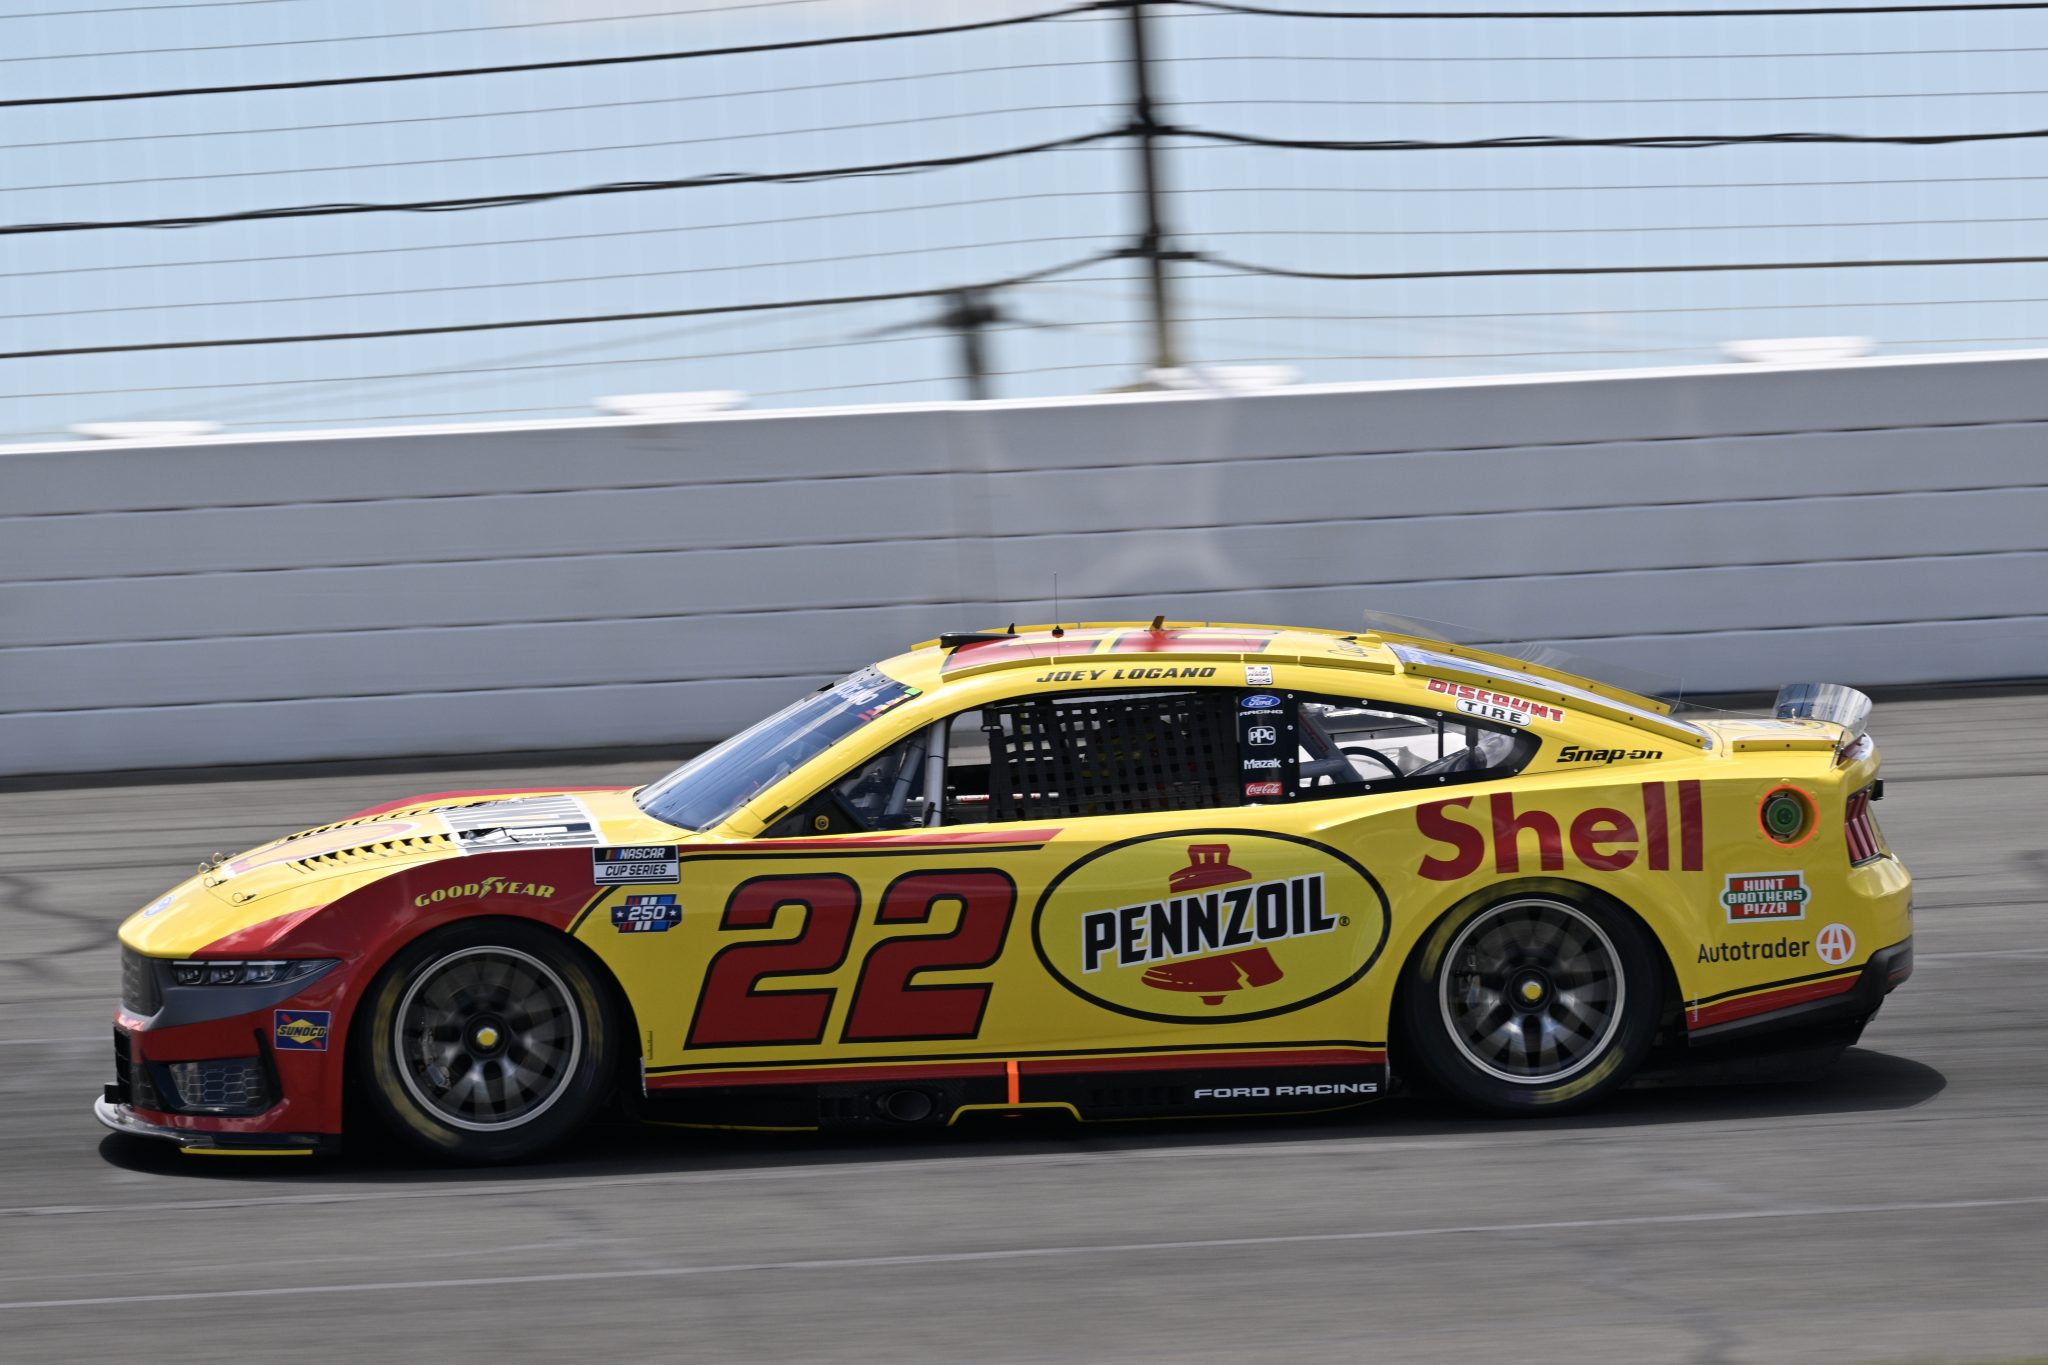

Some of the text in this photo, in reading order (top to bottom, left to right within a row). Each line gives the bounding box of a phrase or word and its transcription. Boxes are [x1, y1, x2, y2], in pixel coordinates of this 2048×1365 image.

[1036, 667, 1217, 683] JOEY LOGANO
[1427, 679, 1564, 722] DISCOUNT
[1464, 701, 1522, 724] TIRE
[1250, 728, 1274, 744] PPG
[1556, 745, 1663, 764] Snap-on
[1243, 758, 1282, 770] Mazak
[1416, 779, 1704, 882] Shell
[619, 847, 666, 860] NASCAR
[605, 864, 668, 877] CUP SERIES
[414, 879, 556, 907] GOODYEAR
[1743, 878, 1785, 892] HUNT
[1727, 889, 1803, 904] BROTHERS
[627, 905, 668, 921] 250
[1743, 901, 1788, 915] PIZZA
[1082, 872, 1339, 973] PENNZOIL
[1697, 936, 1811, 964] Autotrader
[683, 867, 1018, 1051] 22
[279, 1025, 327, 1037] SUNOCO
[1193, 1082, 1378, 1099] FORD RACING
